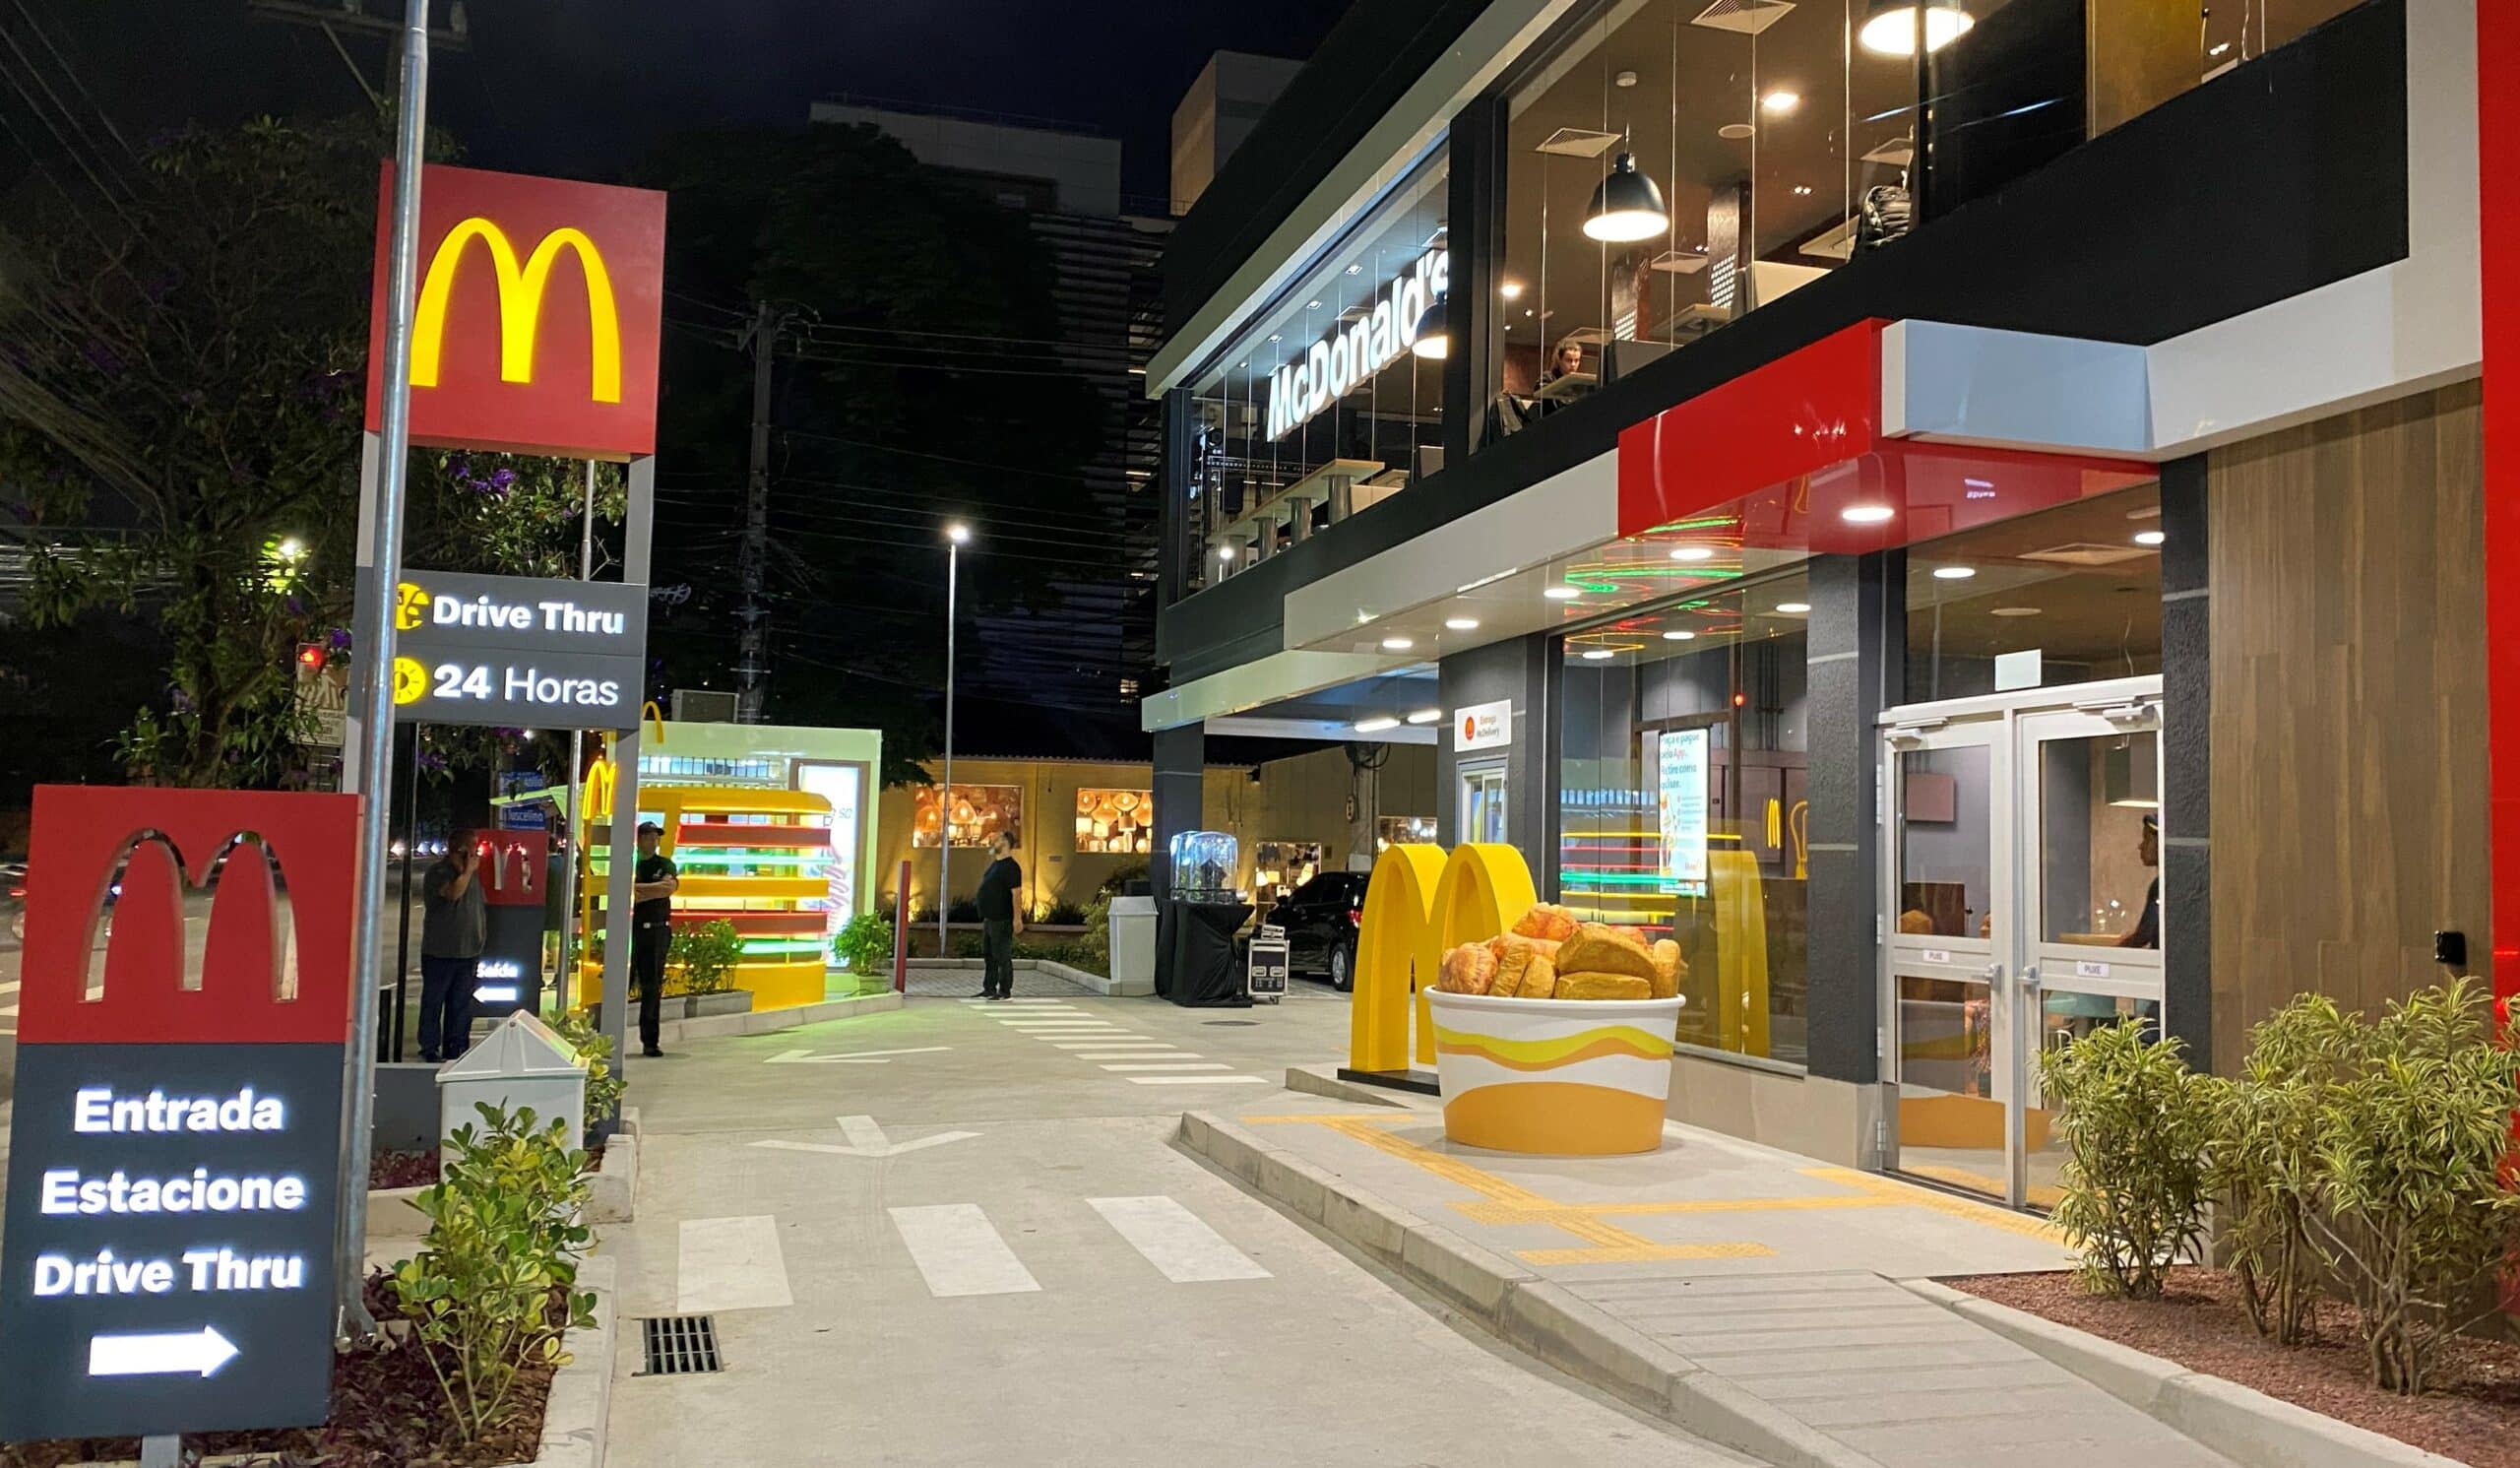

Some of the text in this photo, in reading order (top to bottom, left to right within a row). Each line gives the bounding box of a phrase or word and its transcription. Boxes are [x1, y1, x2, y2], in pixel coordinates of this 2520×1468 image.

[433, 596, 625, 635] Drive Thru
[433, 664, 619, 706] 24 Horas
[74, 1087, 284, 1133] Entrada
[41, 1167, 305, 1215] Estacione
[34, 1248, 302, 1296] Drive Thru
